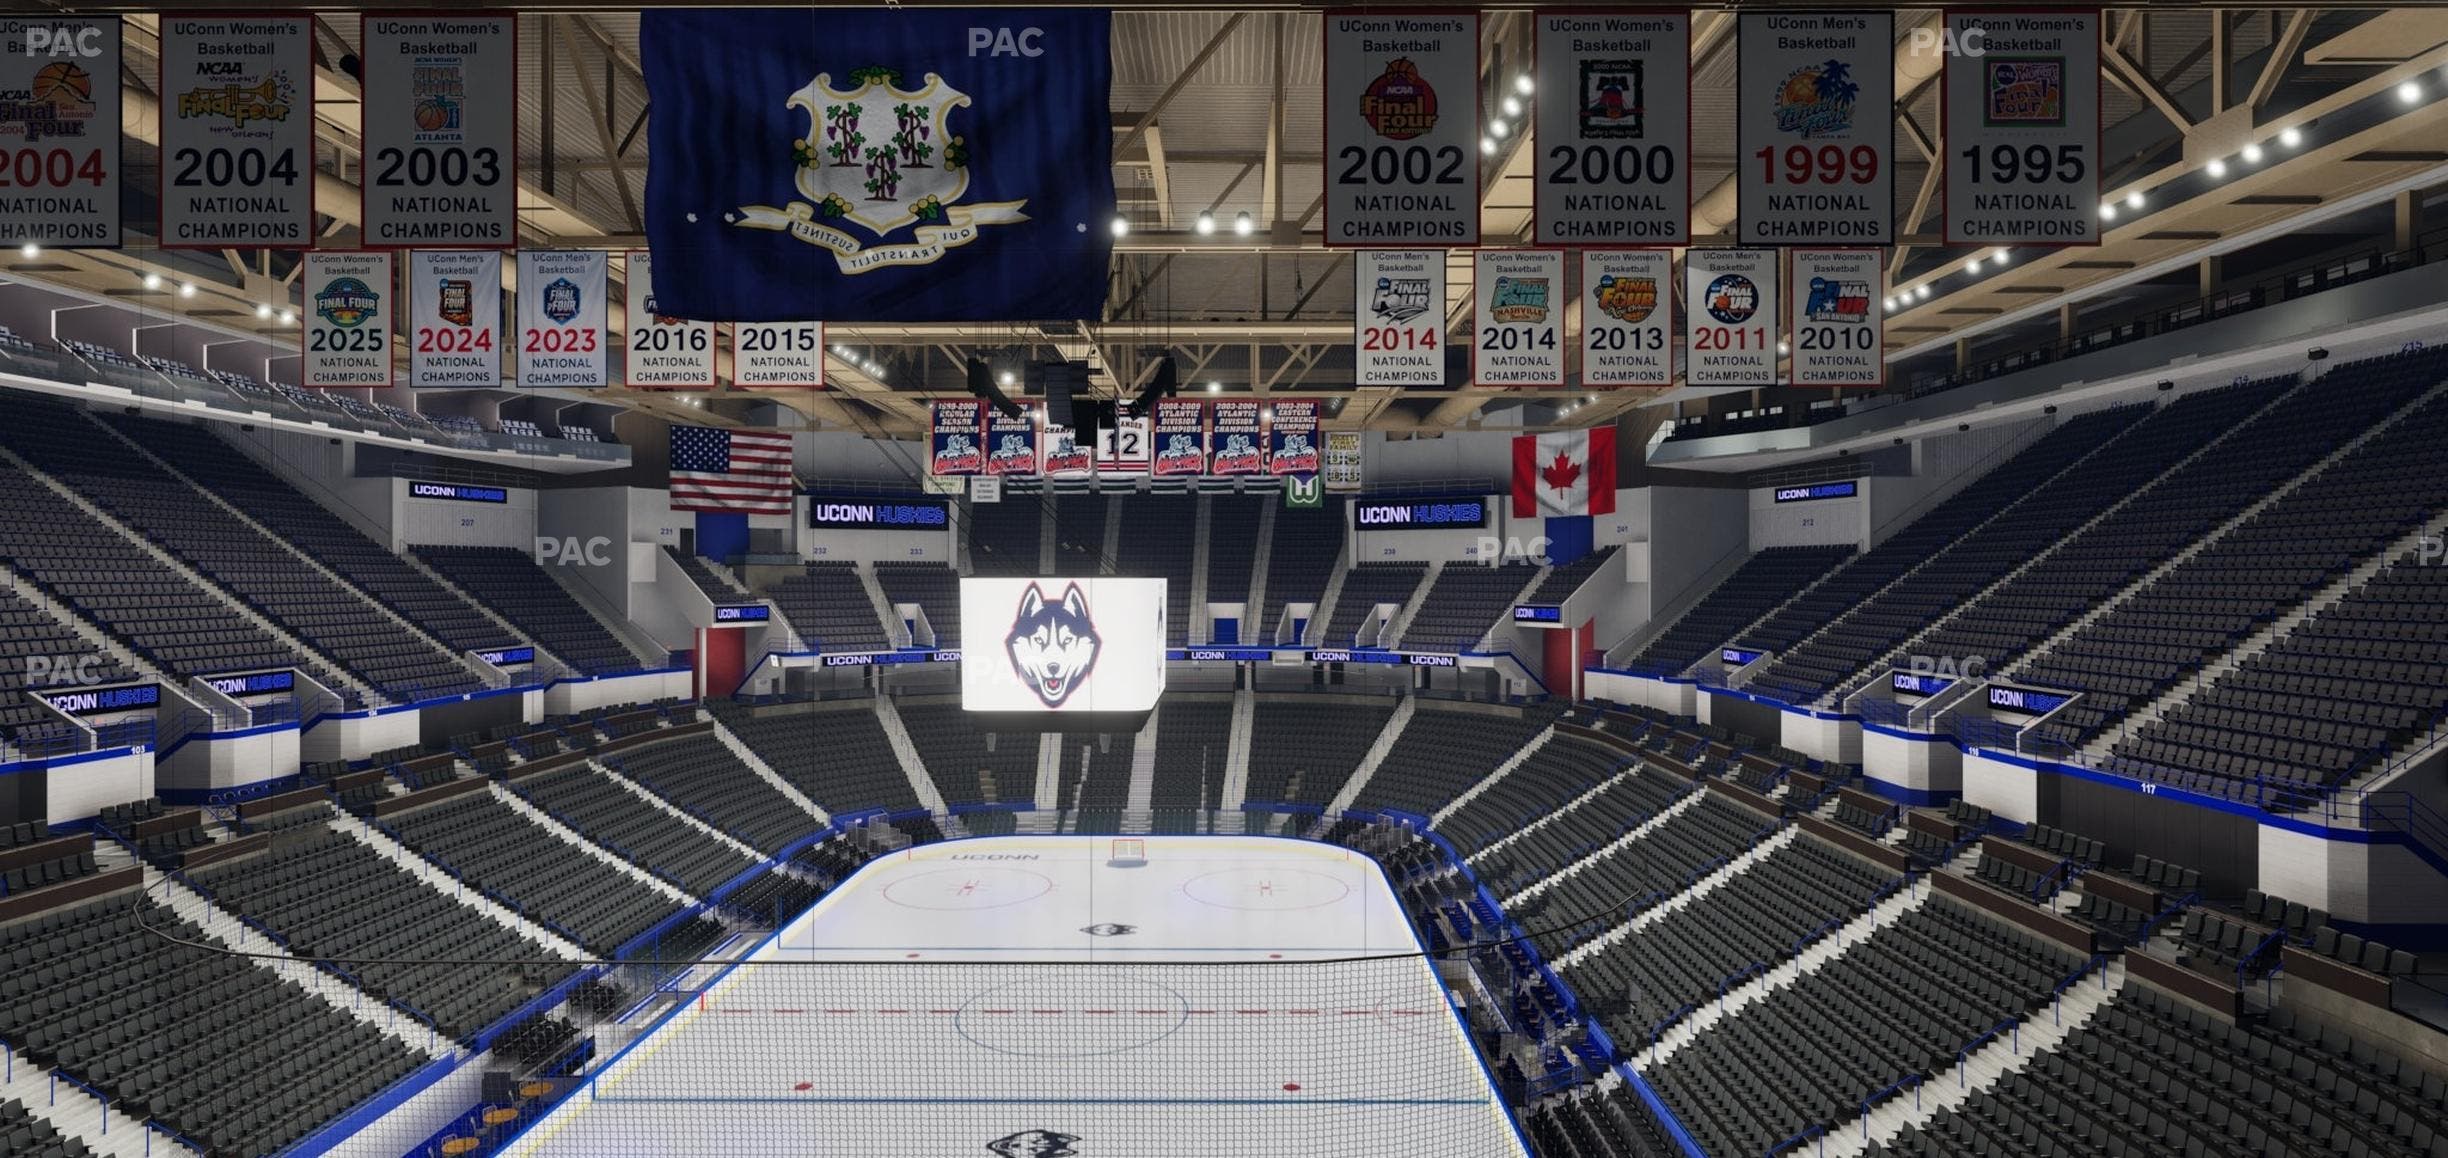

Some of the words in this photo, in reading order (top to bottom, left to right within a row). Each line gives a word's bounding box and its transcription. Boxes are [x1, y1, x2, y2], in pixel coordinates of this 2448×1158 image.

[175, 22, 225, 35] UConn
[231, 22, 297, 35] Women's
[377, 22, 427, 35] UConn
[433, 22, 500, 35] Women's
[1339, 20, 1390, 32] UConn
[1396, 20, 1463, 32] Women's
[1550, 19, 1600, 32] UConn
[1606, 19, 1674, 32] Women's
[1768, 17, 1818, 30] UConn
[1823, 17, 1866, 30] Men's
[1960, 18, 2010, 31] UConn
[2015, 18, 2084, 31] Women's
[198, 43, 275, 55] Basketball
[400, 42, 477, 55] Basketball
[1363, 40, 1440, 52] Basketball
[1573, 39, 1650, 52] Basketball
[1778, 37, 1855, 49] Basketball
[1983, 38, 2061, 50] Basketball
[197, 62, 242, 75] NCAA
[1360, 95, 1424, 116] Final
[1377, 113, 1439, 135] Four
[414, 133, 463, 141] ATLANTA
[174, 148, 298, 186] 2004
[376, 148, 500, 186] 2003
[1338, 145, 1464, 185] 2002
[1549, 145, 1674, 184] 2000
[1756, 145, 1878, 184] 1999
[1963, 145, 2085, 184] 1995
[0, 198, 98, 213] NATIONAL
[190, 198, 290, 213] NATIONAL
[392, 198, 492, 213] NATIONAL
[1355, 196, 1456, 211] NATIONAL
[1565, 195, 1666, 210] NATIONAL
[1769, 195, 1870, 210] NATIONAL
[1975, 195, 2076, 210] NATIONAL
[178, 223, 299, 238] CHAMPIONS
[381, 223, 502, 238] CHAMPIONS
[1343, 221, 1466, 236] CHAMPIONS
[1553, 221, 1676, 236] CHAMPIONS
[1757, 220, 1879, 235] CHAMPIONS
[1963, 220, 2085, 235] CHAMPIONS
[311, 255, 342, 263] UConn
[344, 255, 383, 263] Women's
[428, 255, 458, 263] UConn
[460, 255, 484, 263] Men's
[533, 254, 562, 262] UConn
[566, 254, 591, 262] Men's
[1372, 252, 1402, 260] UConn
[1404, 252, 1429, 260] Men's
[1483, 254, 1513, 262] UConn
[1515, 254, 1555, 262] Women's
[1590, 254, 1621, 262] UConn
[1623, 254, 1663, 262] Women's
[1703, 252, 1733, 260] UConn
[1736, 252, 1761, 260] Men's
[1801, 254, 1830, 262] UConn
[1833, 254, 1873, 262] Women's
[539, 266, 586, 274] Basketball
[1378, 264, 1423, 272] Basketball
[1496, 265, 1542, 273] Basketball
[1604, 265, 1650, 273] Basketball
[1710, 263, 1755, 271] Basketball
[1814, 264, 1859, 272] Basketball
[1390, 280, 1430, 294] FINAL
[1616, 279, 1656, 292] FINAL
[443, 288, 466, 299] FINAL
[550, 289, 576, 301] FINAL
[1602, 285, 1657, 308] FOUR
[1721, 285, 1753, 299] FINAL
[319, 296, 347, 310] FINAL
[348, 296, 377, 310] FOUR
[443, 298, 467, 309] FOUR
[550, 300, 577, 312] FOUR
[1498, 309, 1543, 318] NASHVILLE
[311, 329, 383, 351] 2025
[418, 328, 491, 352] 2024
[526, 329, 596, 352] 2023
[634, 329, 706, 351] 2016
[742, 328, 814, 350] 2015
[1364, 327, 1437, 350] 2014
[1482, 327, 1556, 350] 2014
[1590, 327, 1663, 350] 2013
[1695, 327, 1765, 350] 2011
[1800, 327, 1873, 350] 2010
[320, 358, 378, 367] NATIONAL
[426, 357, 485, 367] NATIONAL
[532, 358, 592, 368] NATIONAL
[643, 357, 701, 367] NATIONAL
[751, 357, 809, 366] NATIONAL
[1372, 356, 1431, 366] NATIONAL
[1491, 356, 1551, 366] NATIONAL
[1600, 356, 1658, 366] NATIONAL
[1704, 356, 1763, 366] NATIONAL
[1809, 356, 1869, 366] NATIONAL
[313, 373, 384, 382] CHAMPIONS
[421, 372, 490, 382] CHAMPIONS
[527, 373, 597, 383] CHAMPIONS
[636, 372, 707, 382] CHAMPIONS
[744, 372, 815, 381] CHAMPIONS
[1365, 372, 1438, 381] CHAMPIONS
[1485, 372, 1557, 381] CHAMPIONS
[1593, 371, 1664, 381] CHAMPIONS
[1697, 371, 1769, 381] CHAMPIONS
[1802, 371, 1874, 381] CHAMPIONS
[1216, 402, 1257, 410] 2003-2004
[1159, 410, 1199, 418] ATLANTIC
[1217, 410, 1256, 418] ATLANTIC
[934, 425, 979, 433] CHAMPIONS
[1156, 425, 1202, 433] CHAMPIONS
[1214, 425, 1260, 433] CHAMPIONS
[1107, 432, 1140, 455] 12
[414, 484, 455, 497] UCONN
[1777, 488, 1809, 500] UCONN
[816, 504, 874, 522] UCONN
[876, 506, 945, 524] HUSKIES
[1360, 505, 1412, 525] UCONN
[1413, 502, 1482, 522] HUSKIES
[717, 607, 740, 619] UCONN
[1515, 607, 1534, 620] UCONN
[827, 655, 872, 665] UCONN
[1191, 652, 1225, 660] UCONN
[1312, 652, 1350, 661] UCONN
[1410, 656, 1453, 666] UCONN
[1723, 649, 1740, 663] UCONN
[248, 672, 294, 691] HUSKIES
[1893, 674, 1920, 692] UCONN
[99, 687, 158, 708] HUSKIES
[1990, 688, 2024, 707] UCONN
[2141, 782, 2156, 794] 117
[951, 853, 1040, 861] UCONN
